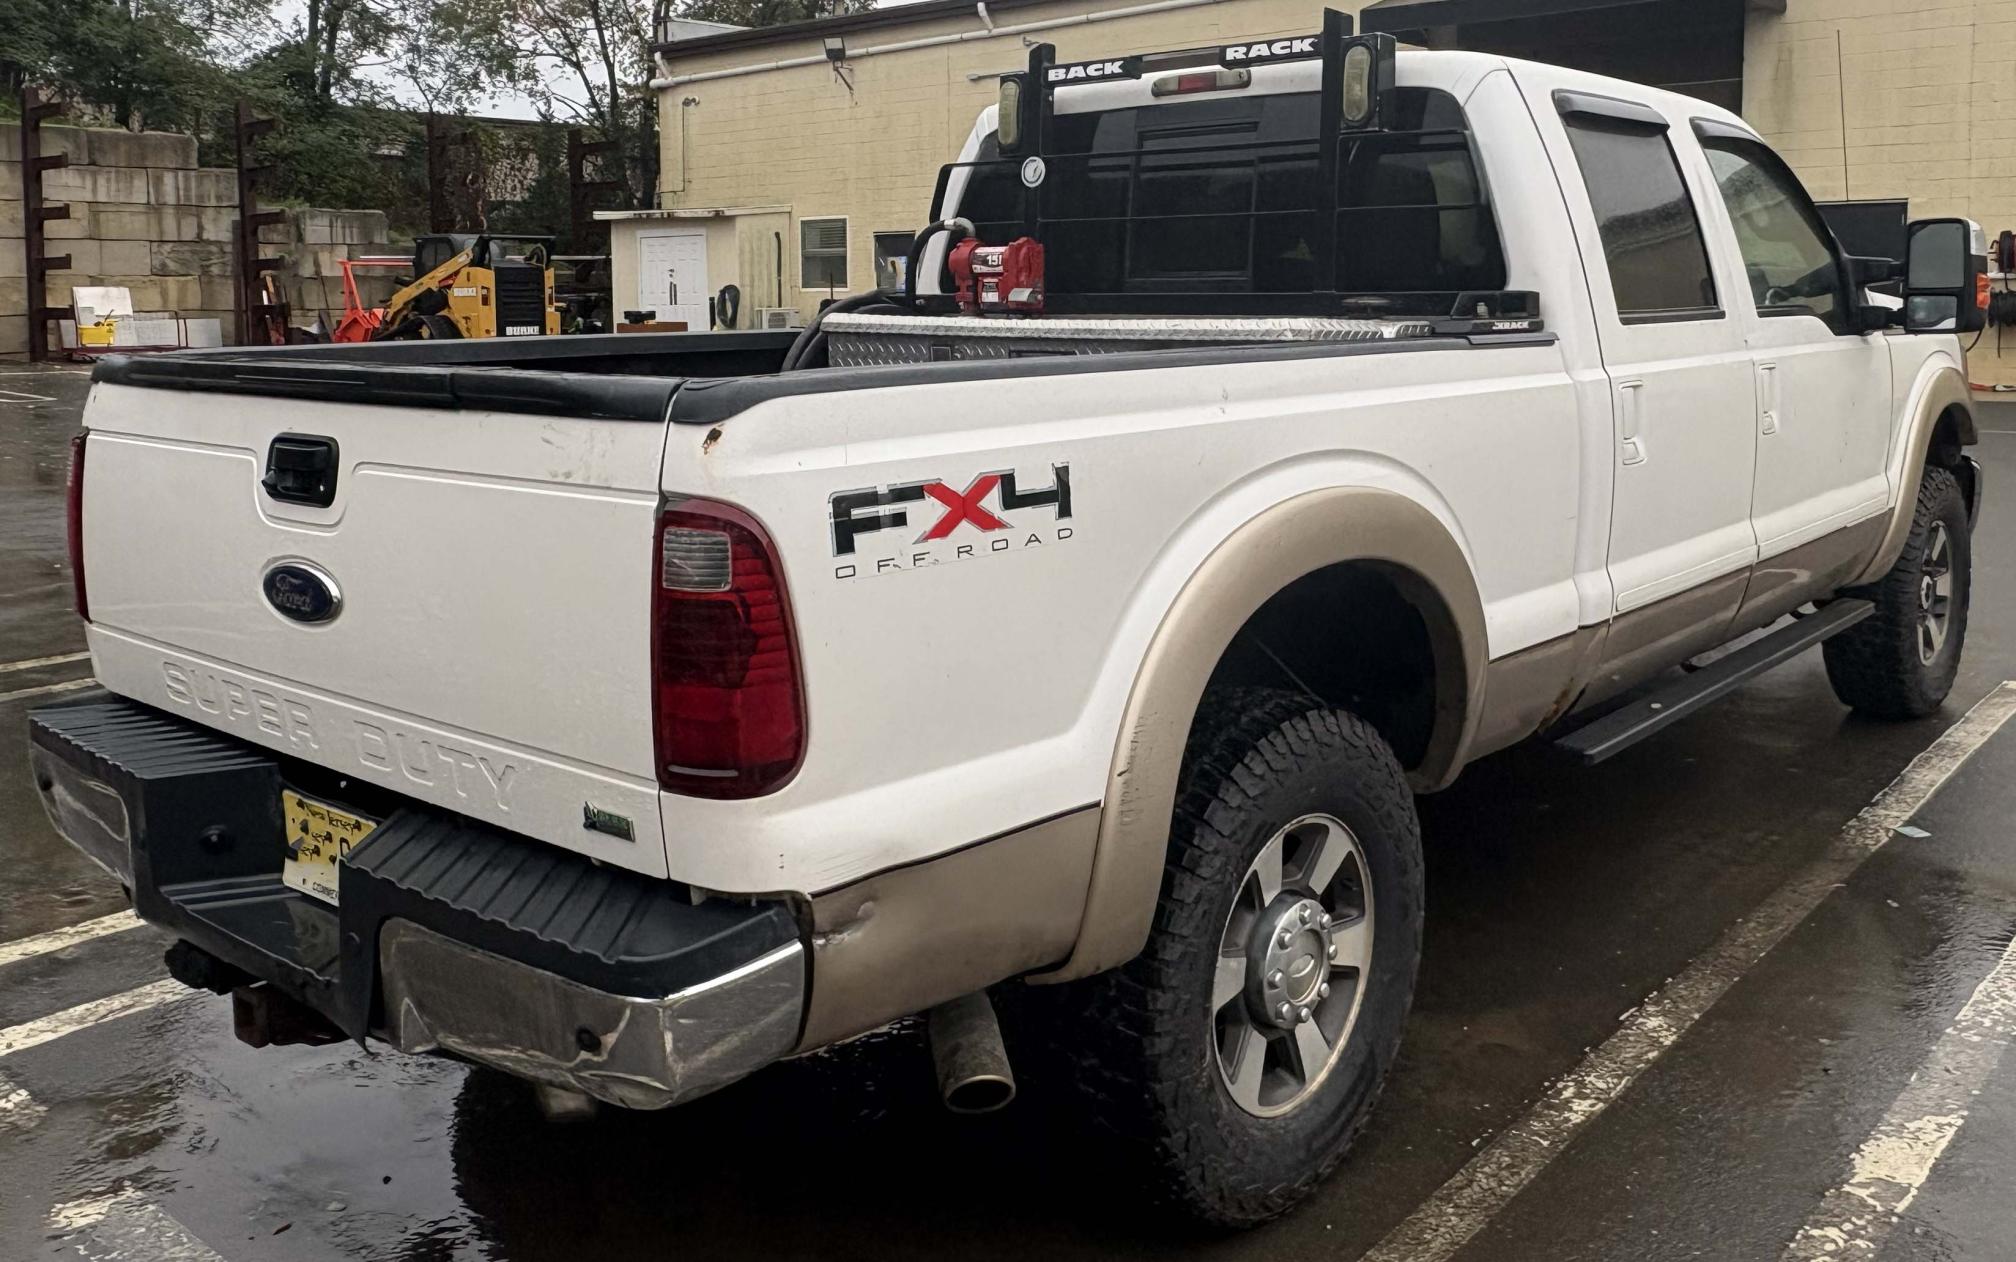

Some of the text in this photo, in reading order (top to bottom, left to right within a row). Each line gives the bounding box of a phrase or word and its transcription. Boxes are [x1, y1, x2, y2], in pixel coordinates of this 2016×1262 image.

[1047, 38, 1316, 82] BACK RACK
[828, 461, 1073, 557] FX4
[162, 660, 517, 811] SUPER DUTY
